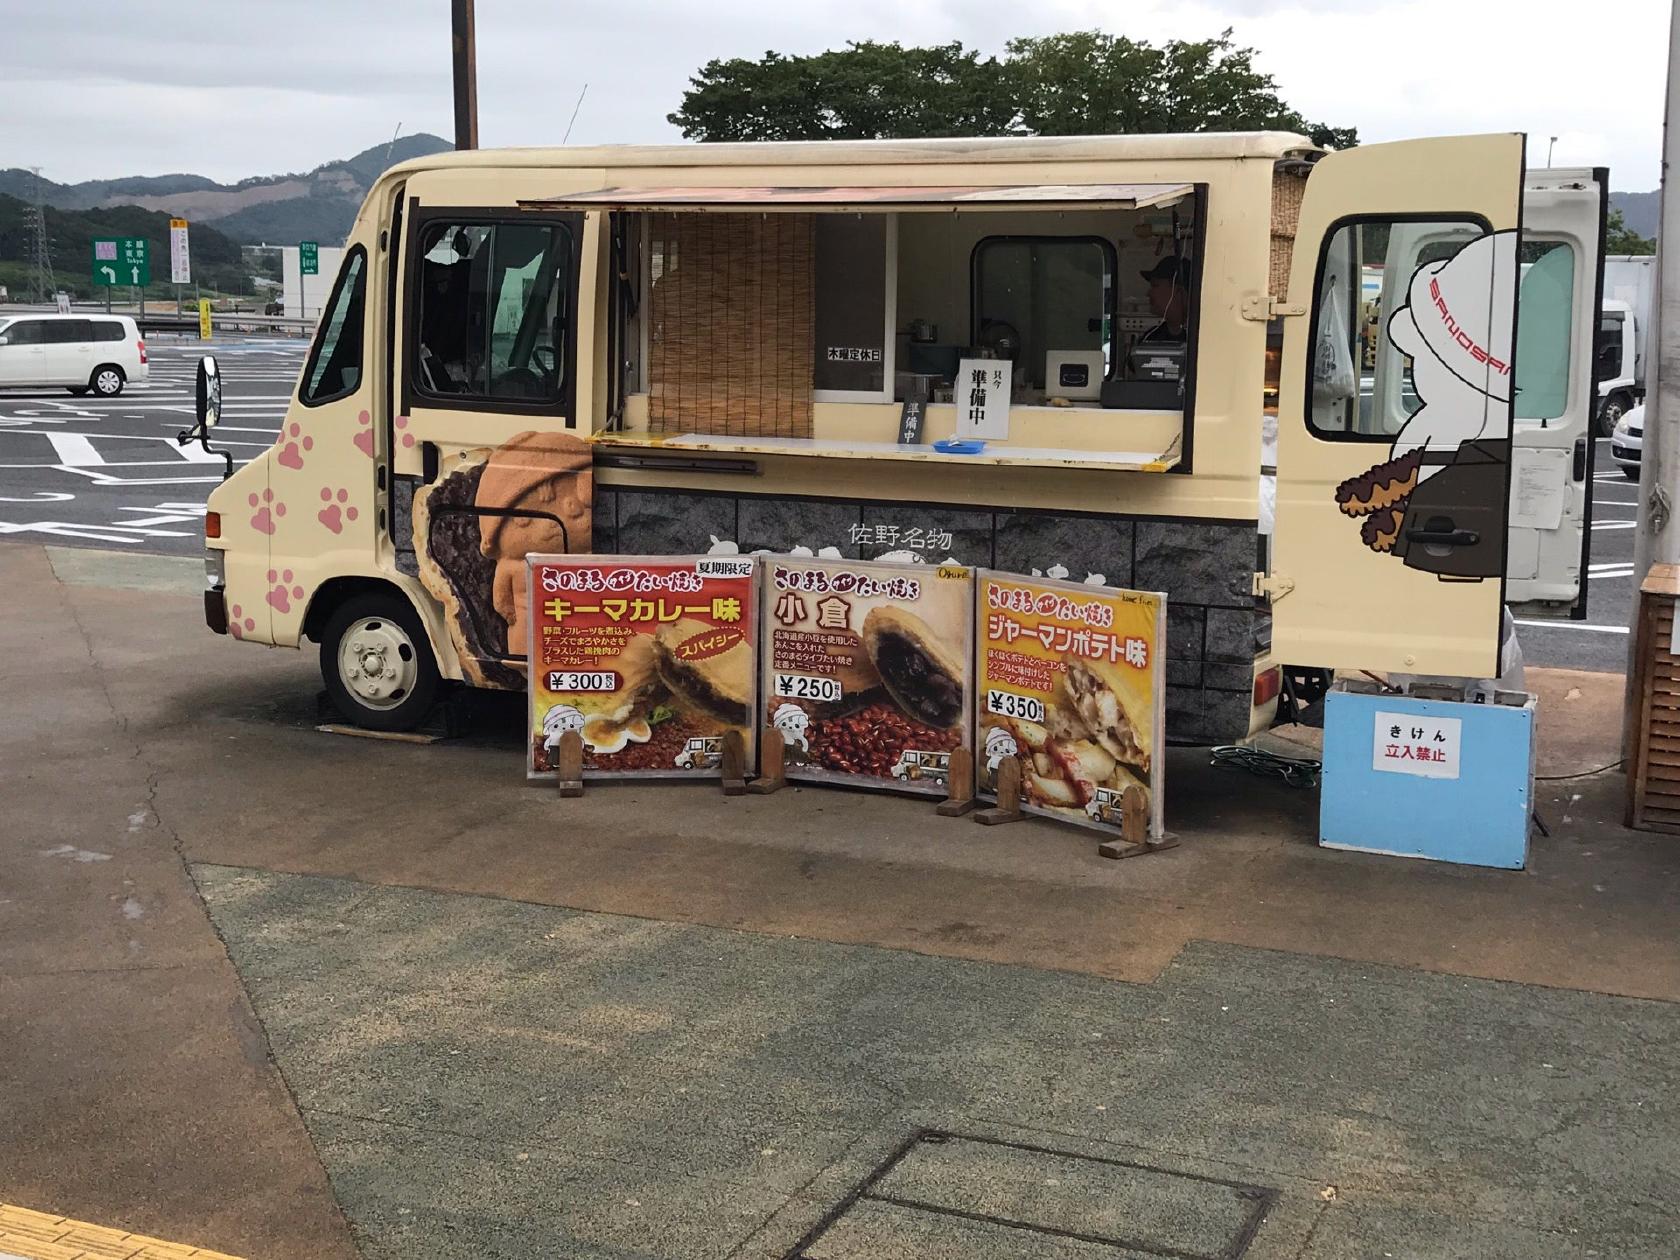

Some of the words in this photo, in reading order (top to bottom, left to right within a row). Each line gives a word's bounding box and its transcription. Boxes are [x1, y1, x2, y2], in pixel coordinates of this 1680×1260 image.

[828, 347, 881, 361] 木曜定休日
[993, 369, 1002, 390] 只今
[969, 369, 988, 425] 準備中
[903, 402, 920, 444] 準備中
[848, 523, 953, 550] 佐野名物
[698, 561, 752, 576] 夏期限定
[543, 597, 741, 623] キーマカレー味
[775, 592, 851, 629] 小倉
[543, 636, 626, 646] チーズでまろやかさを
[774, 630, 858, 647] 北海道産小豆を使用した
[774, 641, 825, 653] あんこを入れた
[989, 615, 1147, 668] ジャーマンポテト味
[774, 650, 853, 666] さのまるタイプたい焼き
[1389, 725, 1446, 742] きけん
[1384, 744, 1446, 762] 立入禁止
